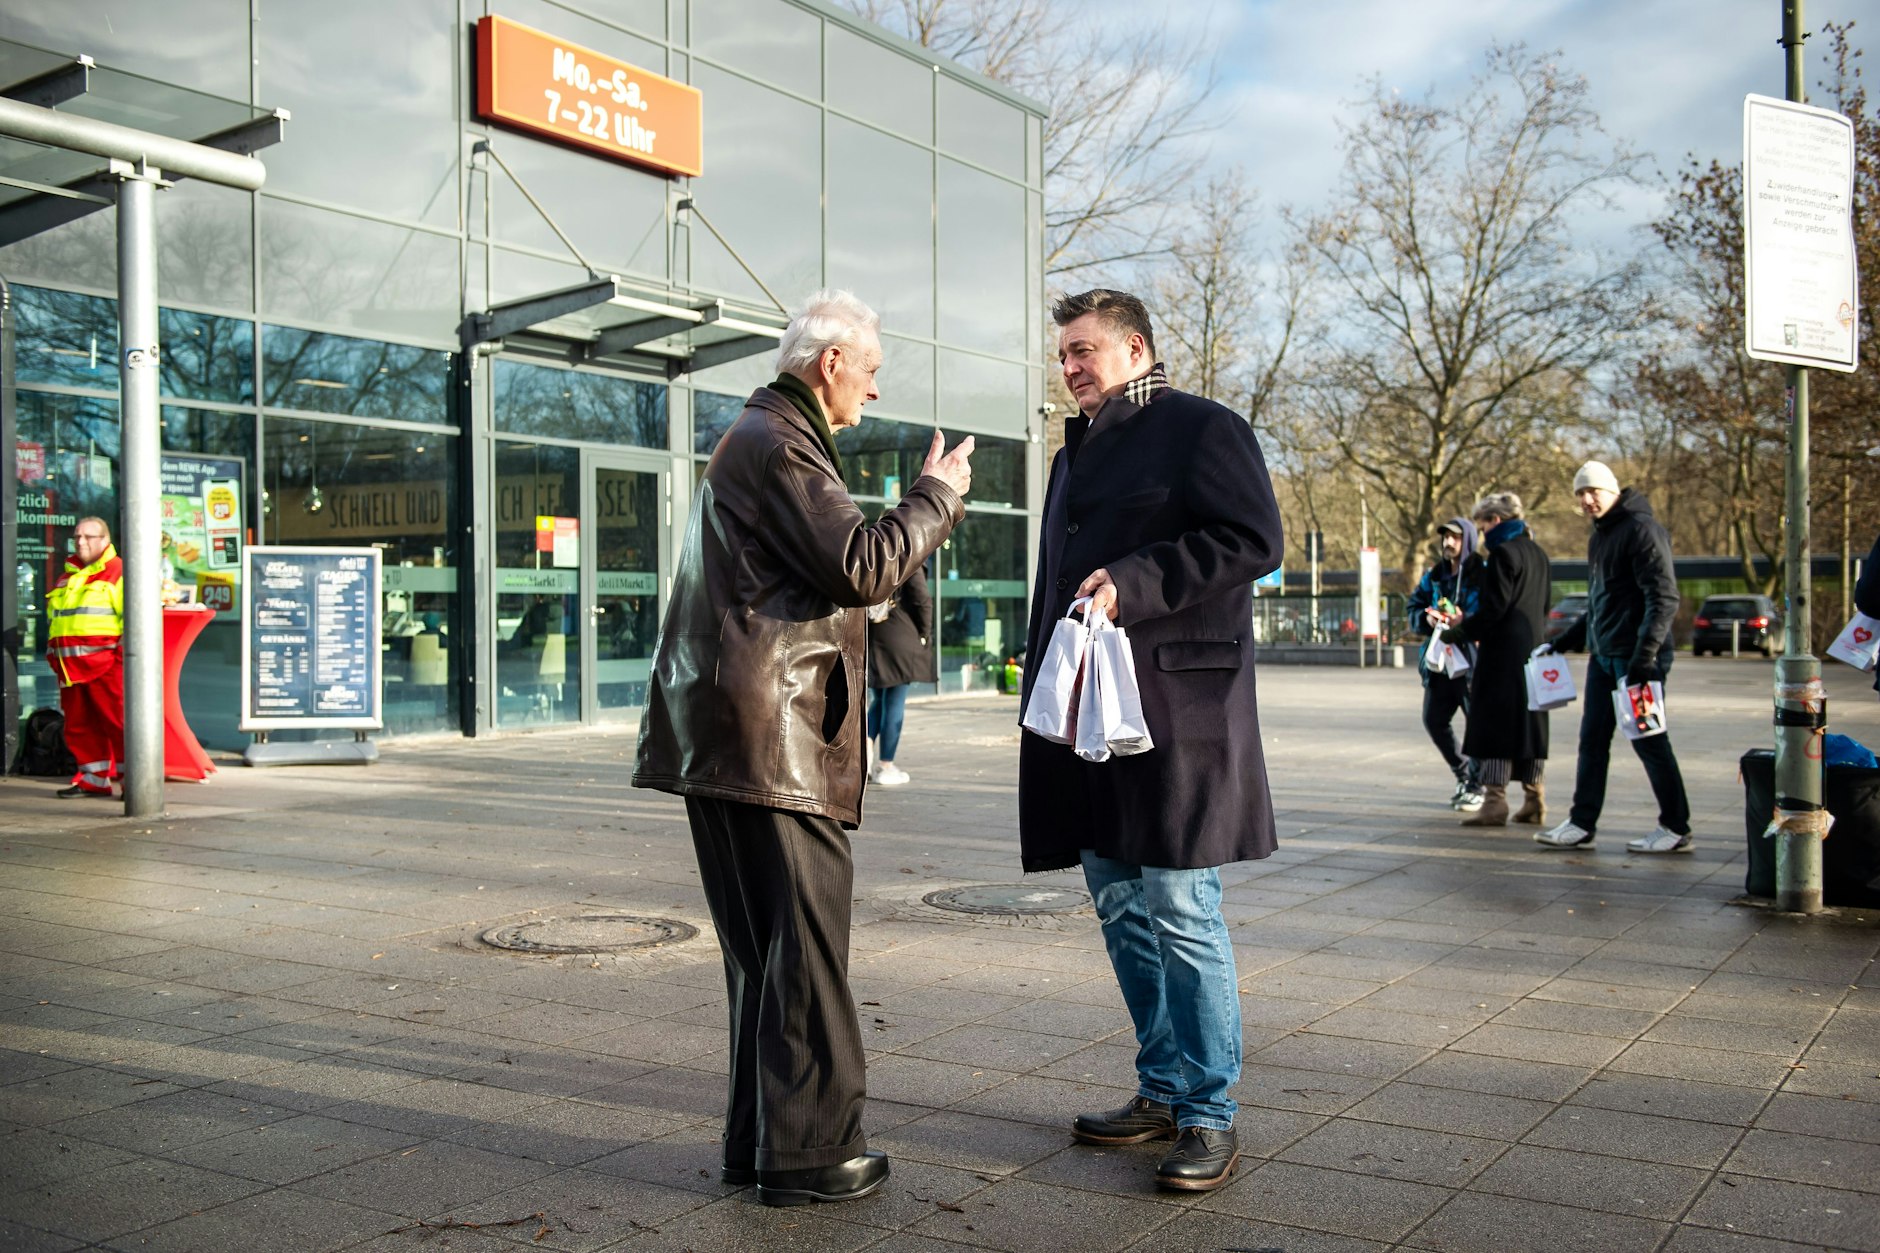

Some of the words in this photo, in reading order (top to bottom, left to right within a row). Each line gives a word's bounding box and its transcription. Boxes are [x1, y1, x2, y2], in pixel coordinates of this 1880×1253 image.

[544, 89, 610, 140] 7-22
[614, 112, 656, 153] Uhr
[1758, 191, 1781, 202] sowie
[1785, 208, 1812, 219] werden
[1814, 213, 1827, 222] zur
[1773, 217, 1803, 231] Anzeige
[1805, 222, 1838, 236] gebracht
[329, 493, 399, 529] SCHNELL
[406, 489, 440, 525] UND
